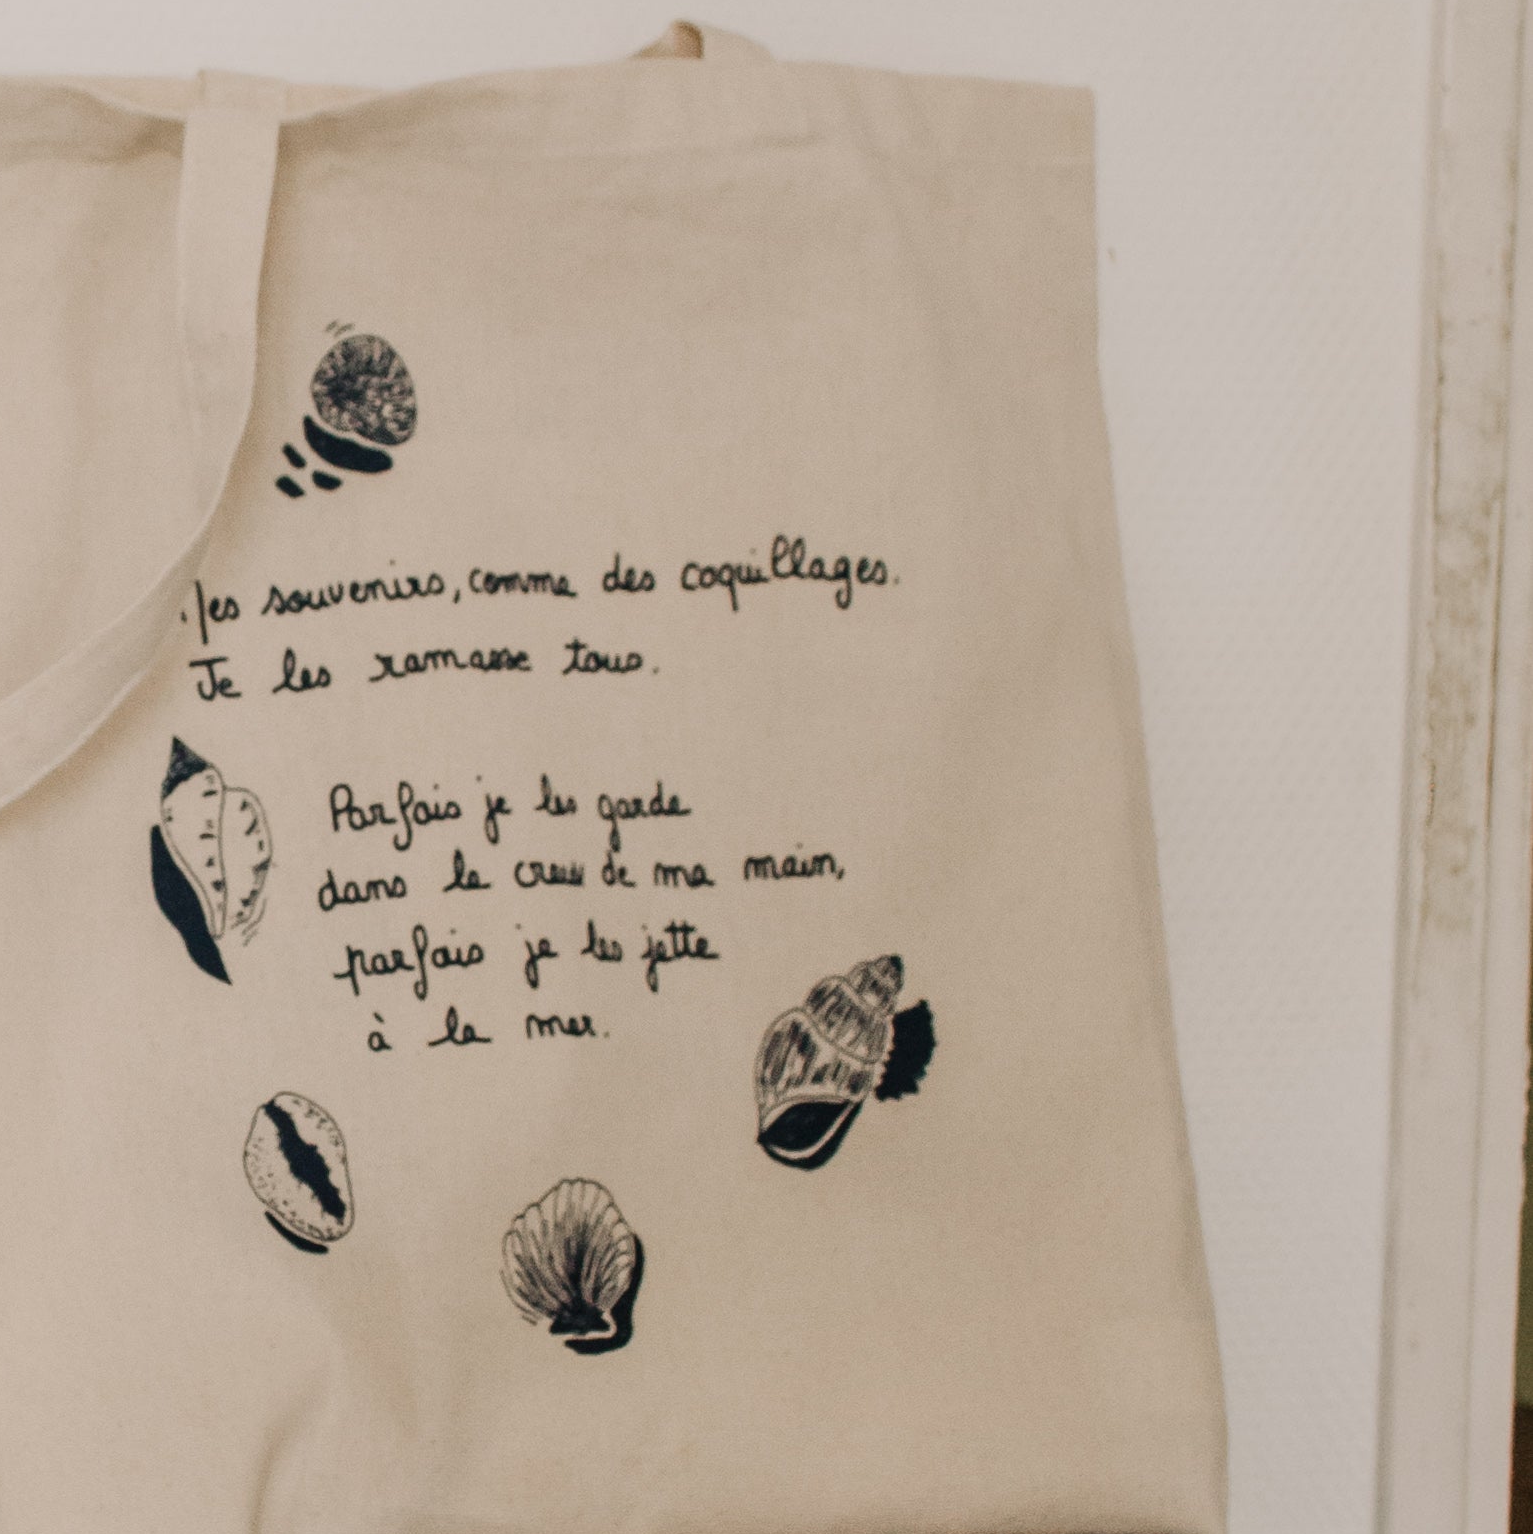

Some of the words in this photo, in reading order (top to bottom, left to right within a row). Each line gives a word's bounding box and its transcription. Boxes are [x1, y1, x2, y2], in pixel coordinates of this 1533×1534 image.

[601, 551, 657, 595] des
[679, 533, 900, 614] coquillages.
[188, 655, 243, 703] Je
[271, 646, 333, 695] les
[367, 646, 533, 684] ramasse
[561, 636, 660, 677] tous.
[475, 775, 513, 847] je
[533, 772, 579, 818] les
[596, 779, 693, 853] garde
[317, 868, 408, 914] dans
[600, 853, 638, 889] de
[652, 861, 717, 890] ma
[742, 843, 846, 882] main,
[515, 923, 560, 991] je
[579, 918, 625, 964] les
[639, 919, 722, 995] jette
[366, 1011, 393, 1054] à
[426, 1004, 494, 1049] la
[524, 1012, 610, 1040] mer.
